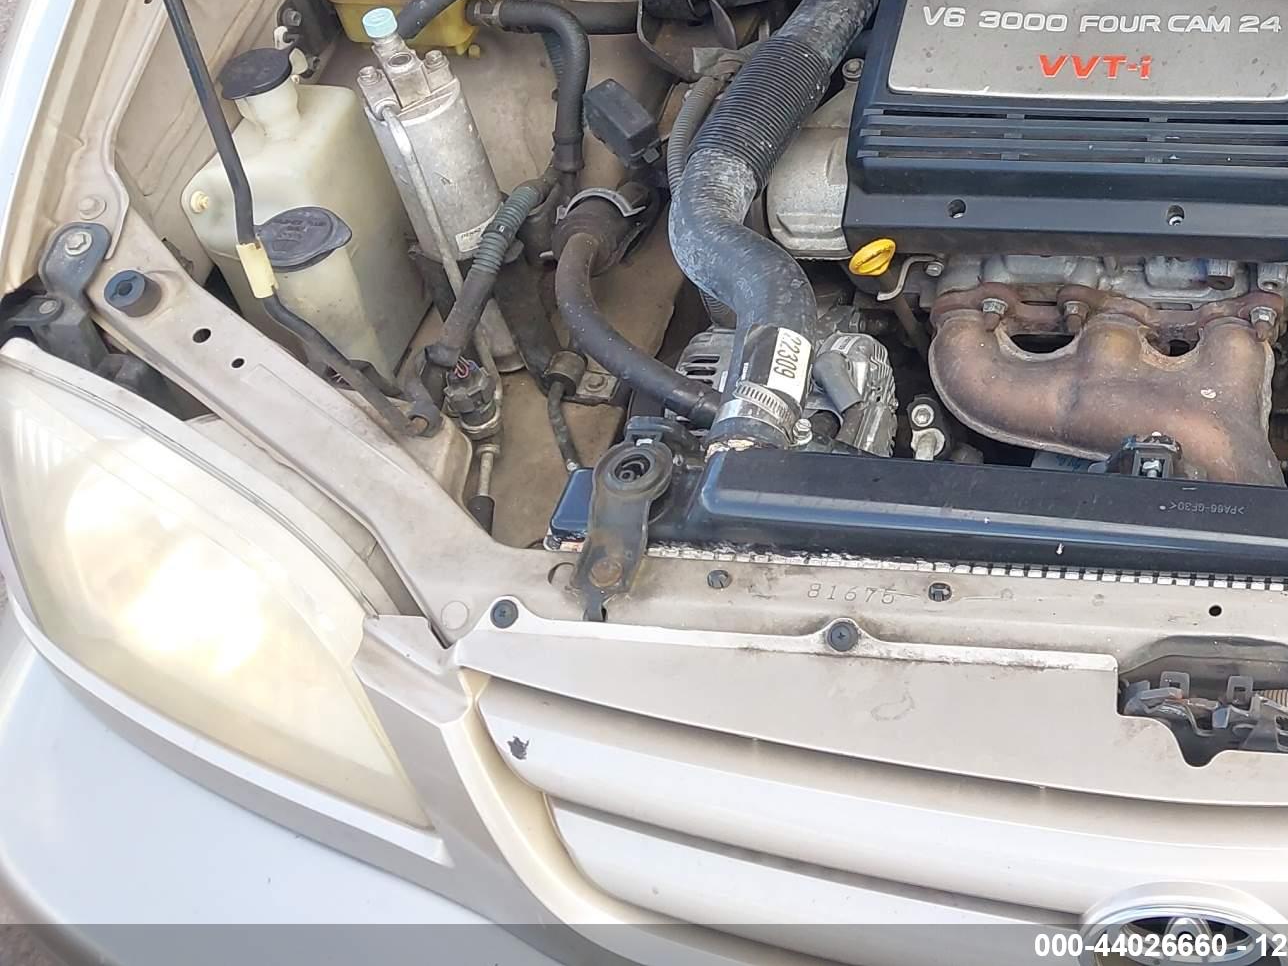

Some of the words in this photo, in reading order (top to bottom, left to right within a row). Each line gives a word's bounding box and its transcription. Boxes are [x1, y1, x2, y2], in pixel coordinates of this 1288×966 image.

[923, 6, 966, 27] V6
[978, 10, 1068, 32] 3000
[1079, 15, 1161, 33] FOUR
[1167, 15, 1231, 33] CAM
[1238, 16, 1281, 33] 24
[1038, 54, 1152, 79] VVT-i
